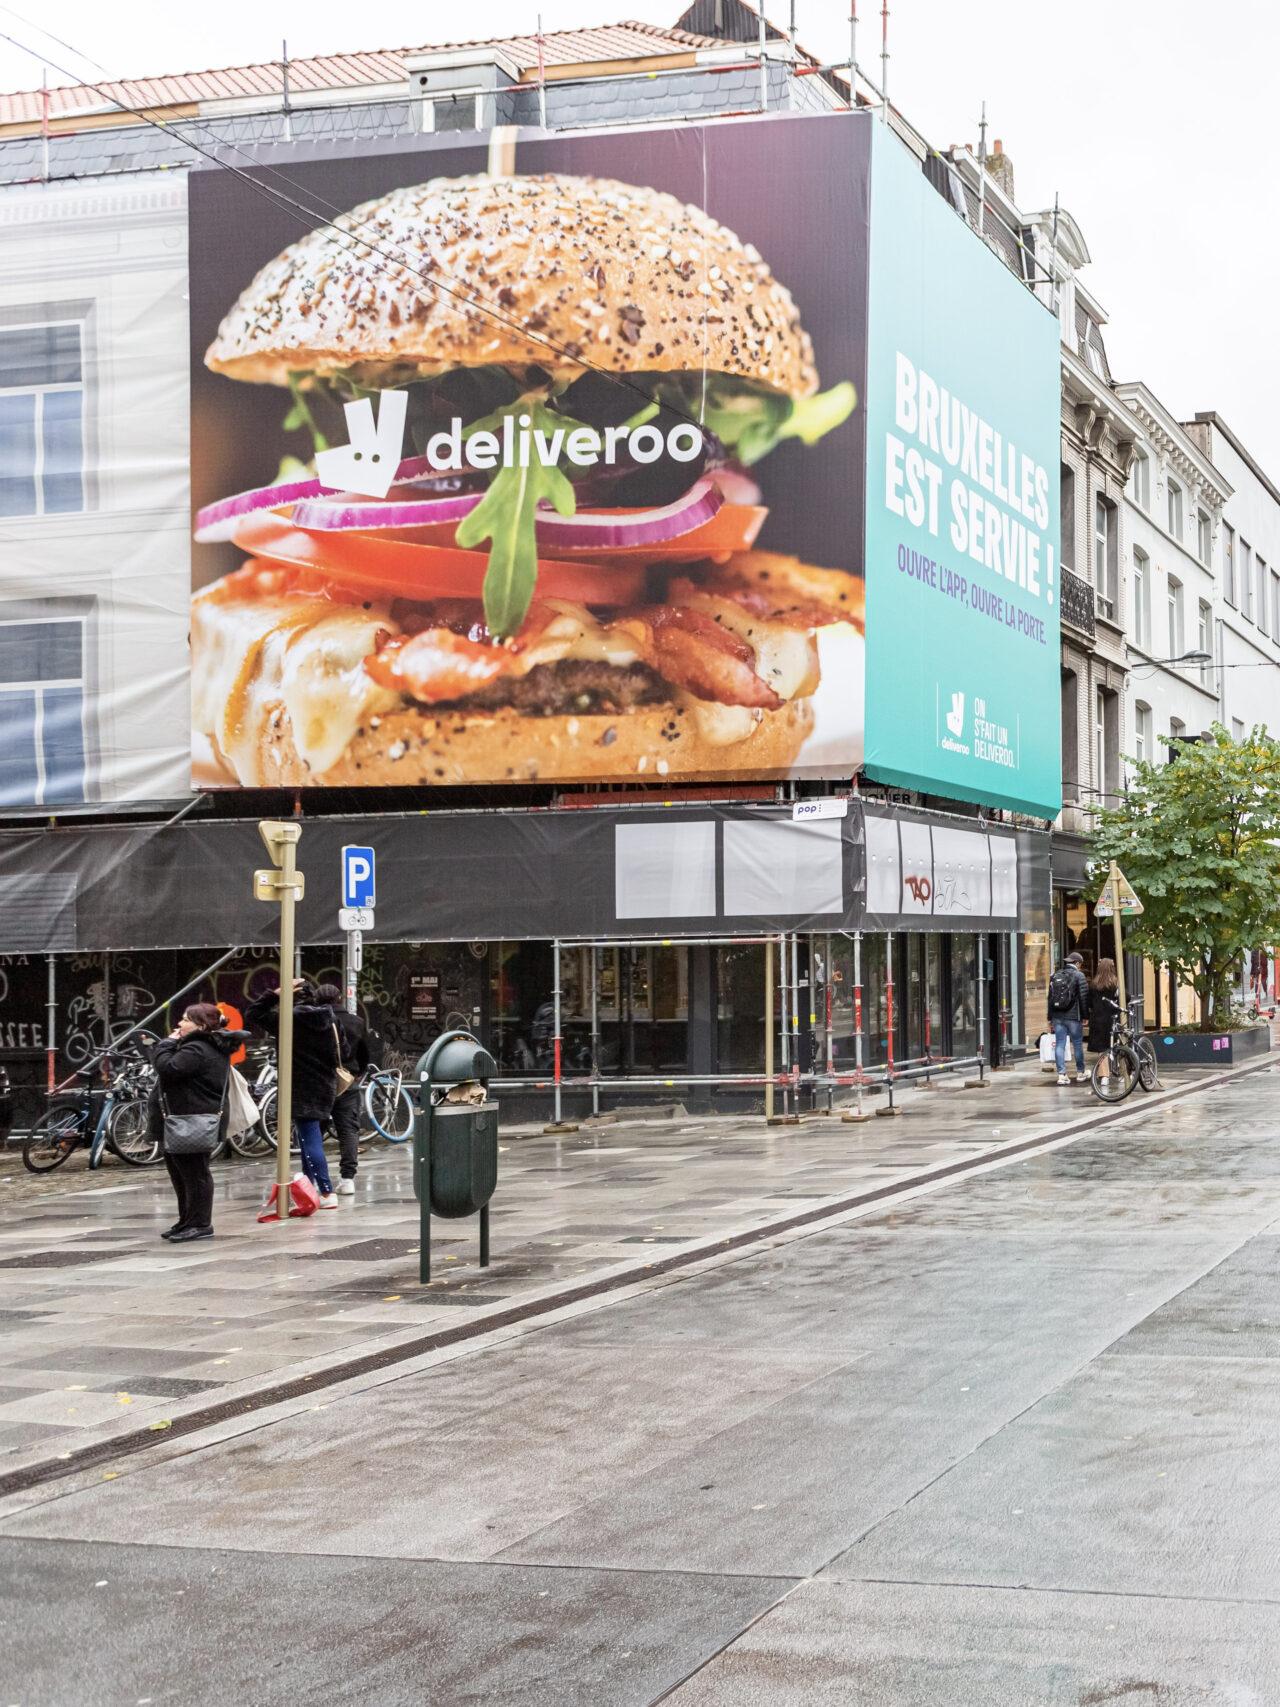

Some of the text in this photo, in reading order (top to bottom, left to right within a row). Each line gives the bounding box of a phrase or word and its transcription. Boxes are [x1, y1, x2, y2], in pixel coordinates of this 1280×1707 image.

[426, 414, 703, 472] deliveroo
[896, 350, 1049, 530] BRUXELLES
[885, 431, 943, 537] EST
[950, 478, 1041, 598] SERVIE
[897, 543, 937, 589] OUVRE
[971, 583, 1003, 622] OUVRE
[1005, 601, 1016, 630] LA
[974, 697, 986, 718] ON
[997, 726, 1008, 746] UN
[797, 805, 817, 814] pop
[348, 856, 370, 899] P
